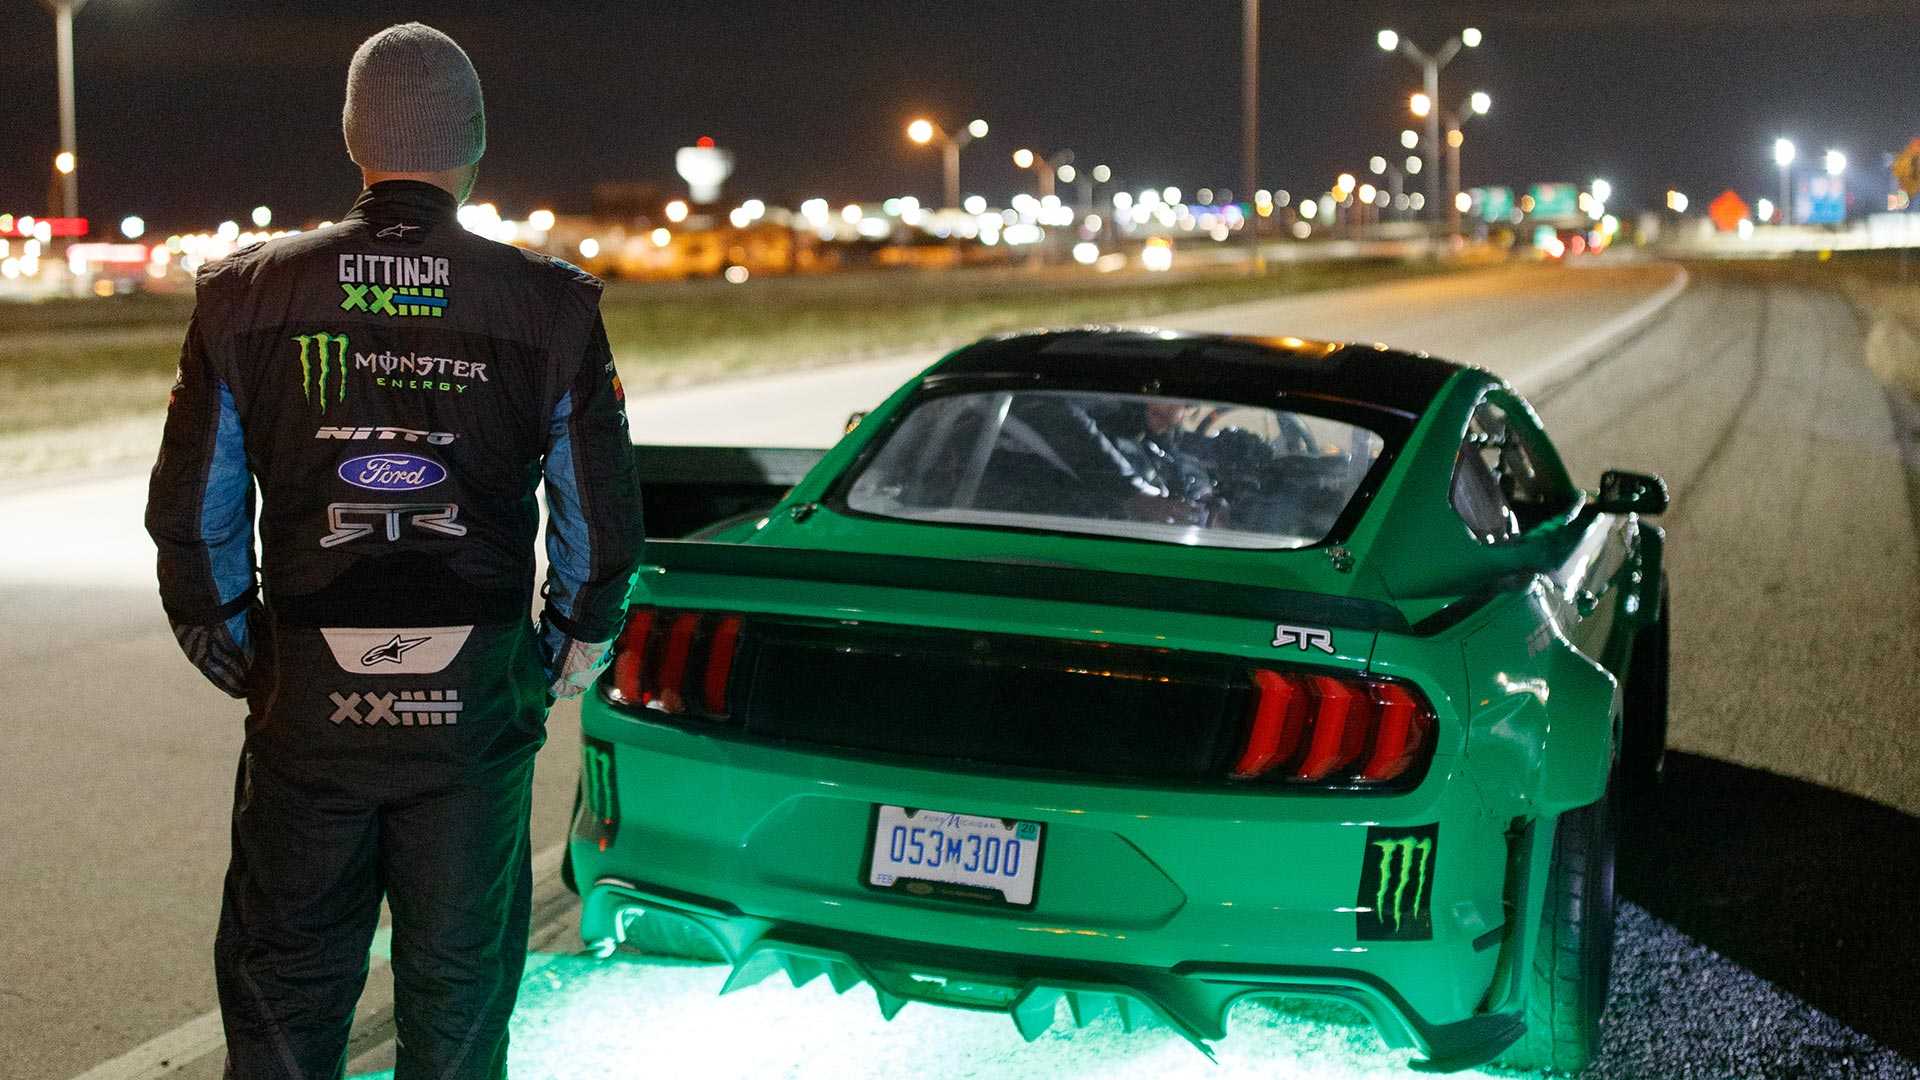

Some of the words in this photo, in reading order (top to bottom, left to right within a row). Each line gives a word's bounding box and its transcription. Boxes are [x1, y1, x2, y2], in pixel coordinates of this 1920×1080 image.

[354, 351, 489, 382] MONSTER
[376, 377, 469, 393] ENERGY
[314, 426, 455, 445] NITTO
[359, 458, 426, 485] Ford
[1021, 823, 1036, 834] 20
[890, 825, 1022, 878] 053M300
